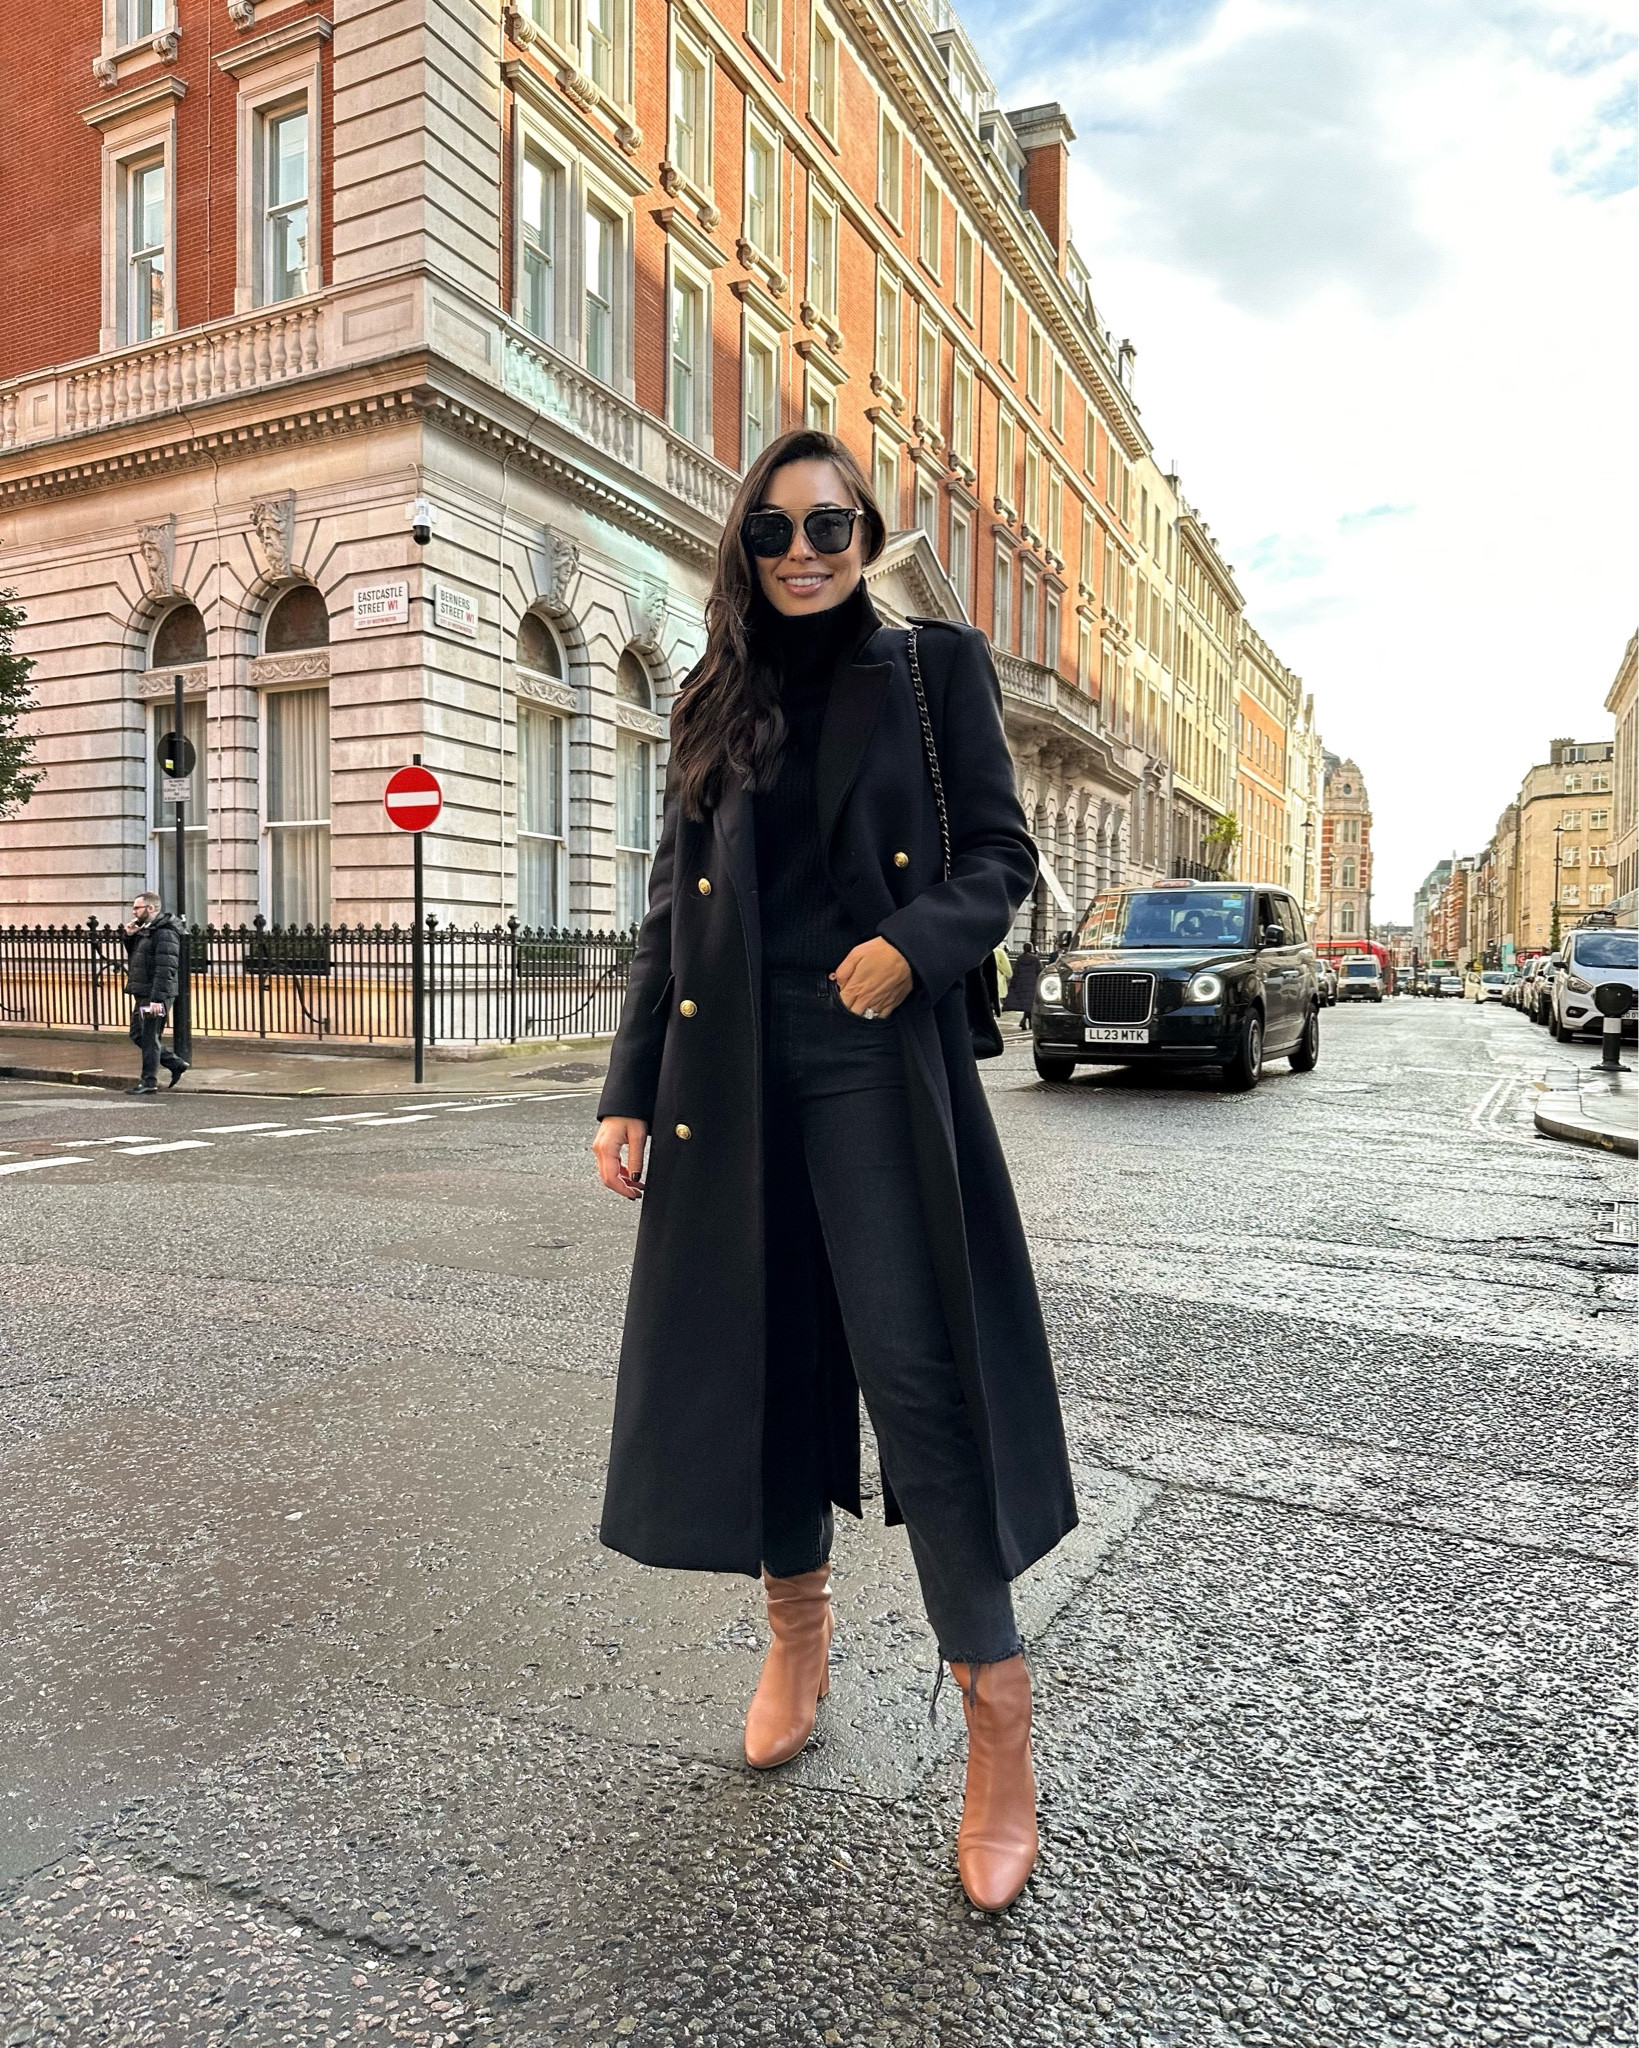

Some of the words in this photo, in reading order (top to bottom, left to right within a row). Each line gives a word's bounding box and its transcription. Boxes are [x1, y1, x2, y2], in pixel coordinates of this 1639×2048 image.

[358, 586, 403, 602] EASTCASTLE
[440, 590, 470, 611] BERNERS
[358, 602, 385, 615] STREET
[387, 600, 398, 611] W1
[440, 602, 464, 620] STREET
[466, 611, 474, 624] W1
[1089, 1029, 1119, 1040] LL23
[1121, 1030, 1144, 1041] MTK
